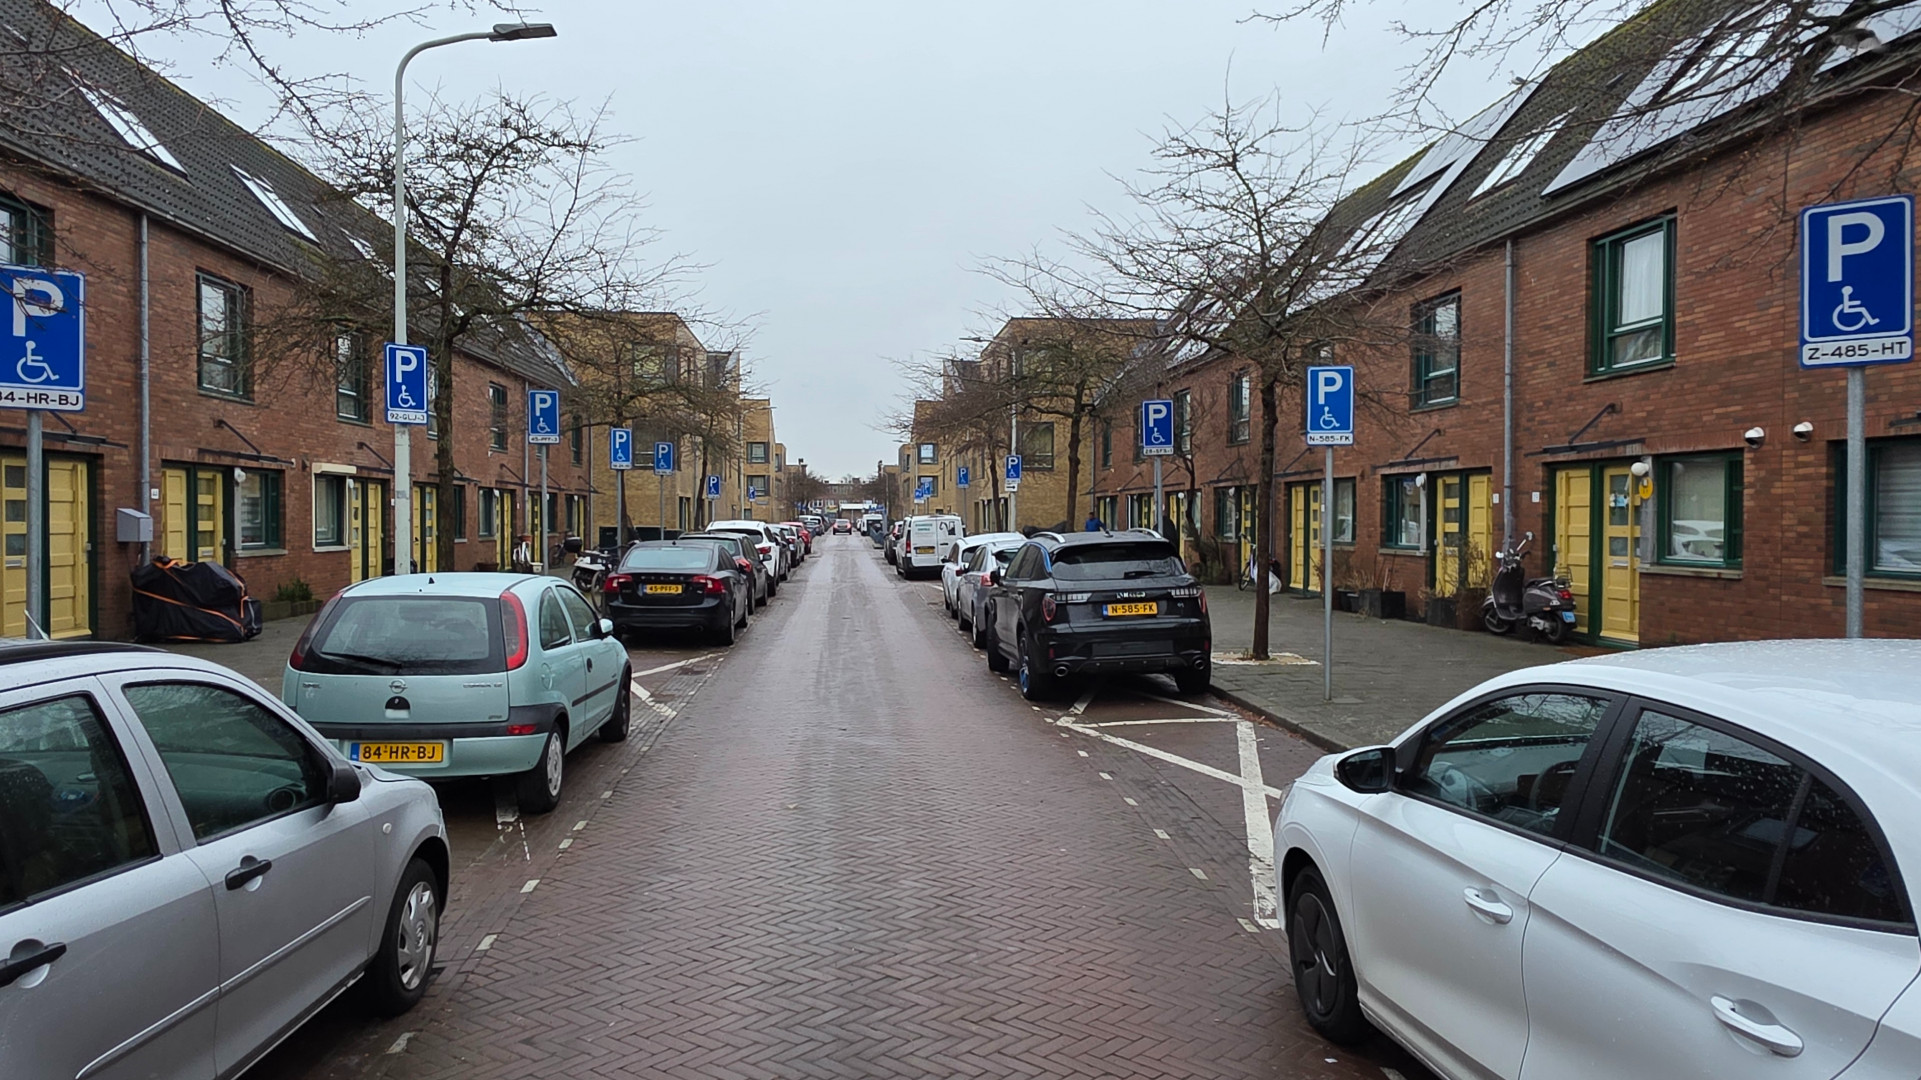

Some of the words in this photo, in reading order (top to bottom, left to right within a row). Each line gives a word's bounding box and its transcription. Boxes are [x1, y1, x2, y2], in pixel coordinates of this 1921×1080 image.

[1827, 211, 1885, 282] P
[13, 278, 64, 337] P
[1807, 341, 1907, 360] Z-485-HT
[396, 350, 418, 383] P
[1318, 371, 1343, 405] P
[0, 391, 80, 406] 4-HR-BJ
[535, 393, 552, 416] P
[1148, 404, 1167, 427] P
[615, 431, 627, 449] P
[1309, 435, 1351, 443] N-585-FK
[659, 444, 669, 459] P
[1008, 457, 1018, 469] P
[960, 468, 967, 477] P
[710, 476, 717, 487] P
[1111, 603, 1155, 614] N-585-FK
[362, 745, 436, 759] 84-HR-BJ
